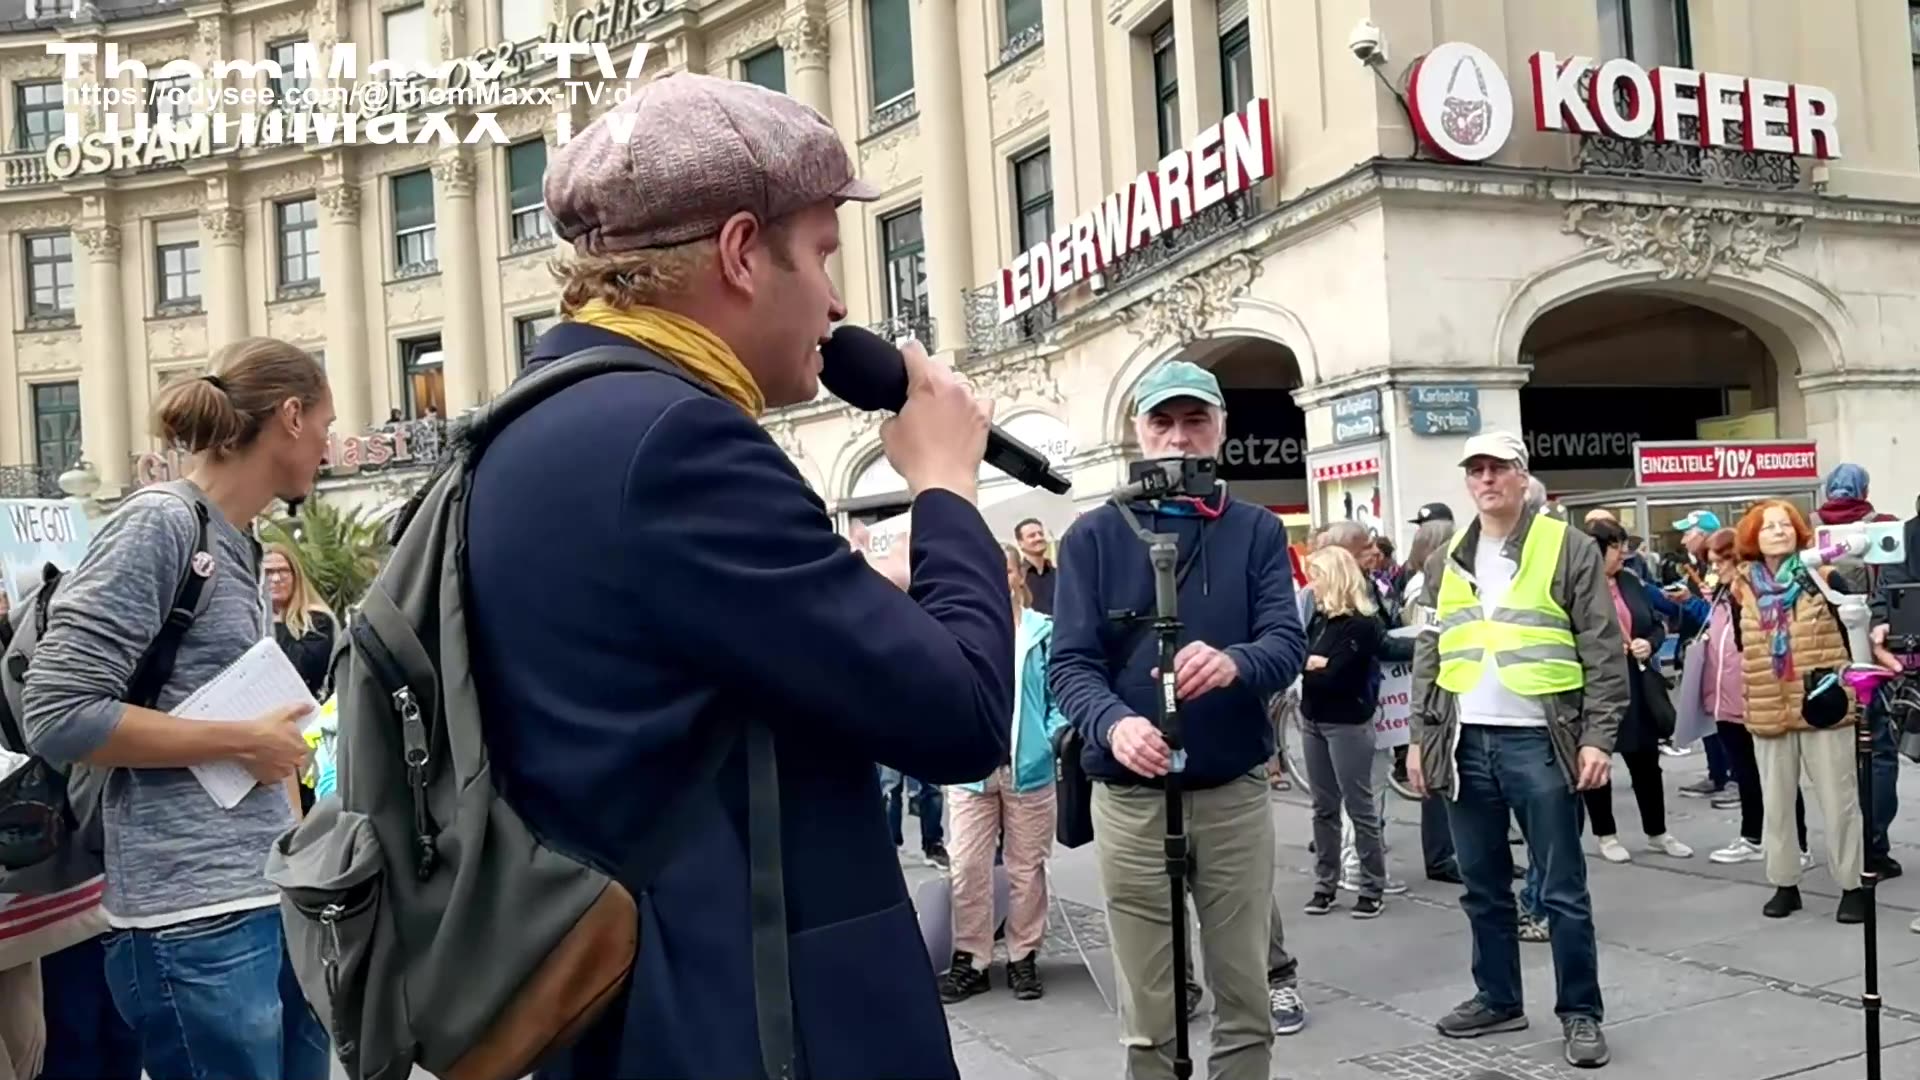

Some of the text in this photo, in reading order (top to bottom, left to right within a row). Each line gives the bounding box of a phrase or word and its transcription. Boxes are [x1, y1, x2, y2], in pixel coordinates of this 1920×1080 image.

[1529, 50, 1841, 159] KOFFER
[45, 116, 211, 178] OSRAM
[998, 98, 1273, 323] LEDERWAREN
[1641, 447, 1815, 478] EINZELTEILE 70% REDUZIERT
[8, 505, 72, 543] WE GOT
